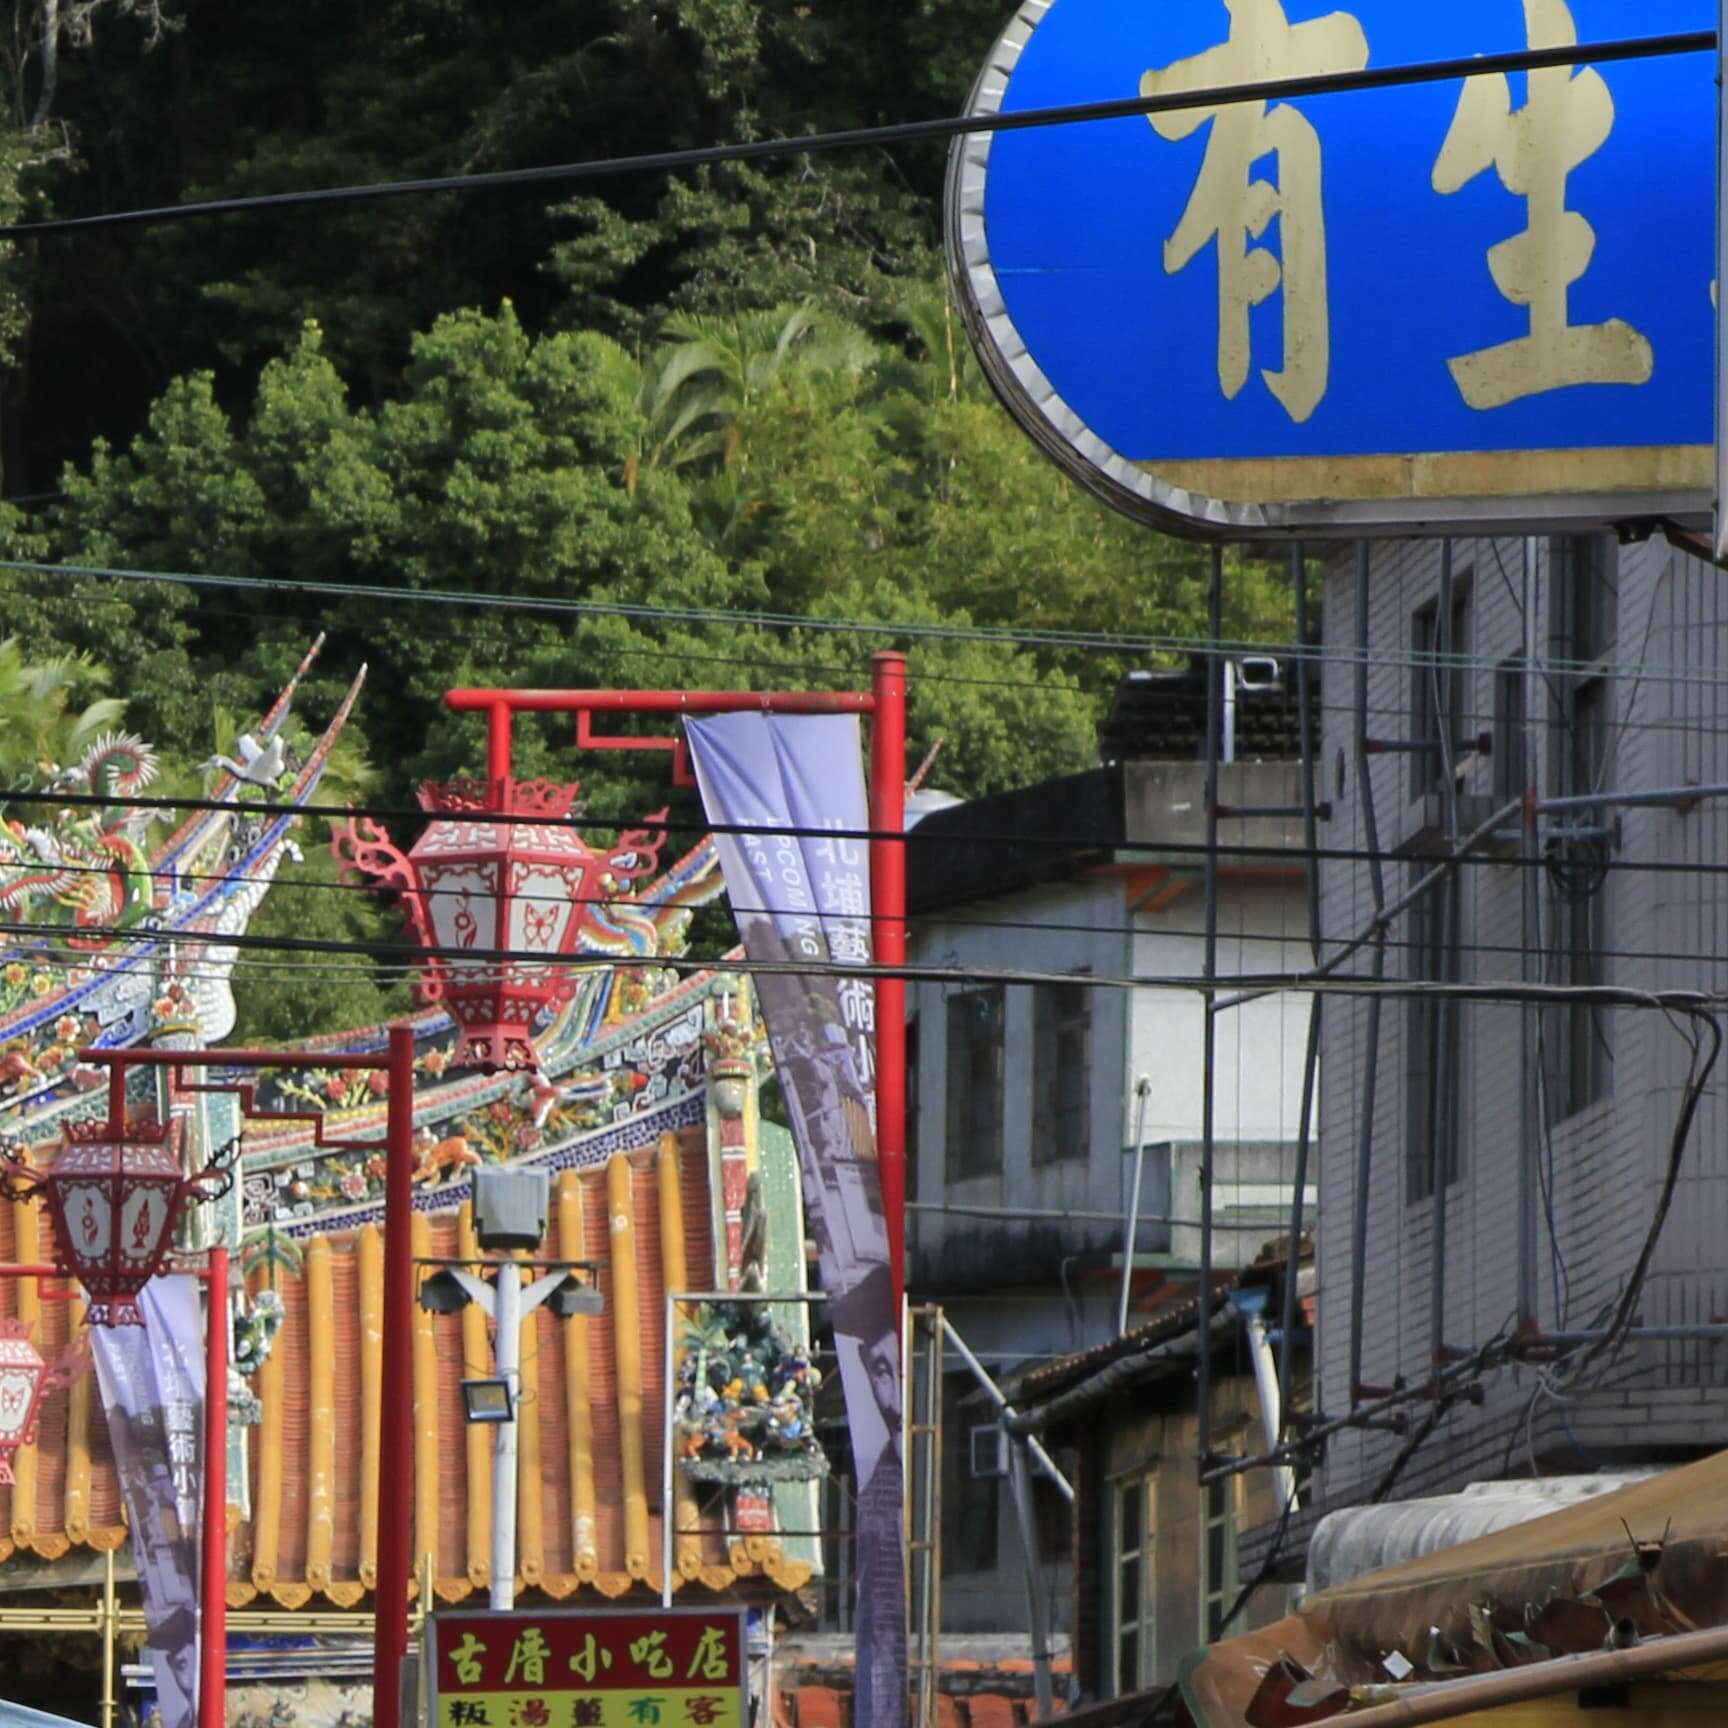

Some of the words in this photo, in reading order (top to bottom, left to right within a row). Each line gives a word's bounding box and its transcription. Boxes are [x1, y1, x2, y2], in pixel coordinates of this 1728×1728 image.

[448, 1626, 730, 1685] 古厝小吃店
